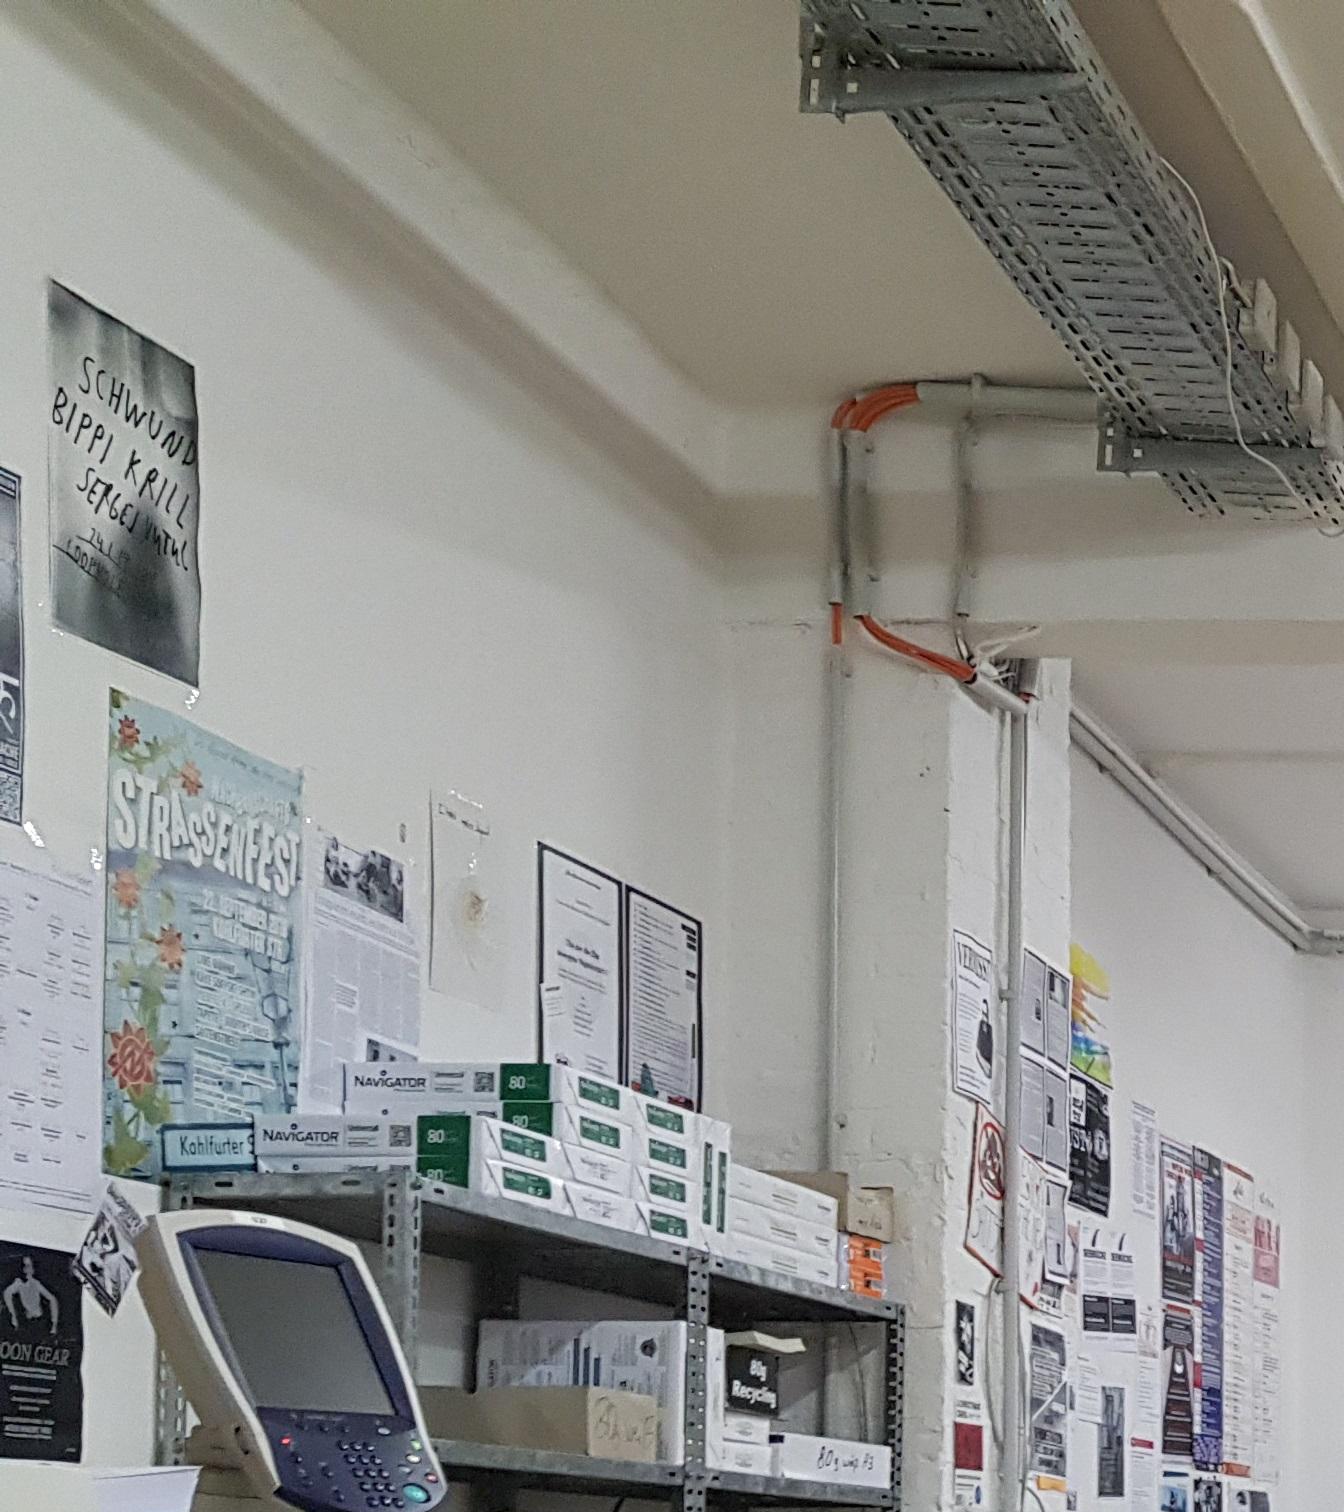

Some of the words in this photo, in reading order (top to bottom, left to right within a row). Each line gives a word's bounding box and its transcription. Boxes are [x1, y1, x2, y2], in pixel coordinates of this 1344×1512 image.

[79, 356, 196, 466] SCHWUND
[53, 386, 113, 464] BIPPI
[125, 449, 190, 529] KRILL
[76, 468, 139, 533] SERGEJ
[113, 768, 300, 897] STRASSENFEST
[354, 1074, 427, 1088] NAVIGATOR
[508, 1075, 526, 1090] 80
[179, 1134, 244, 1157] Kohlfurter
[262, 1129, 339, 1144] NAVIGATOR
[427, 1129, 443, 1144] 80
[34, 1345, 71, 1367] GEAR
[750, 1359, 768, 1382] 80g
[732, 1379, 777, 1409] Recycling
